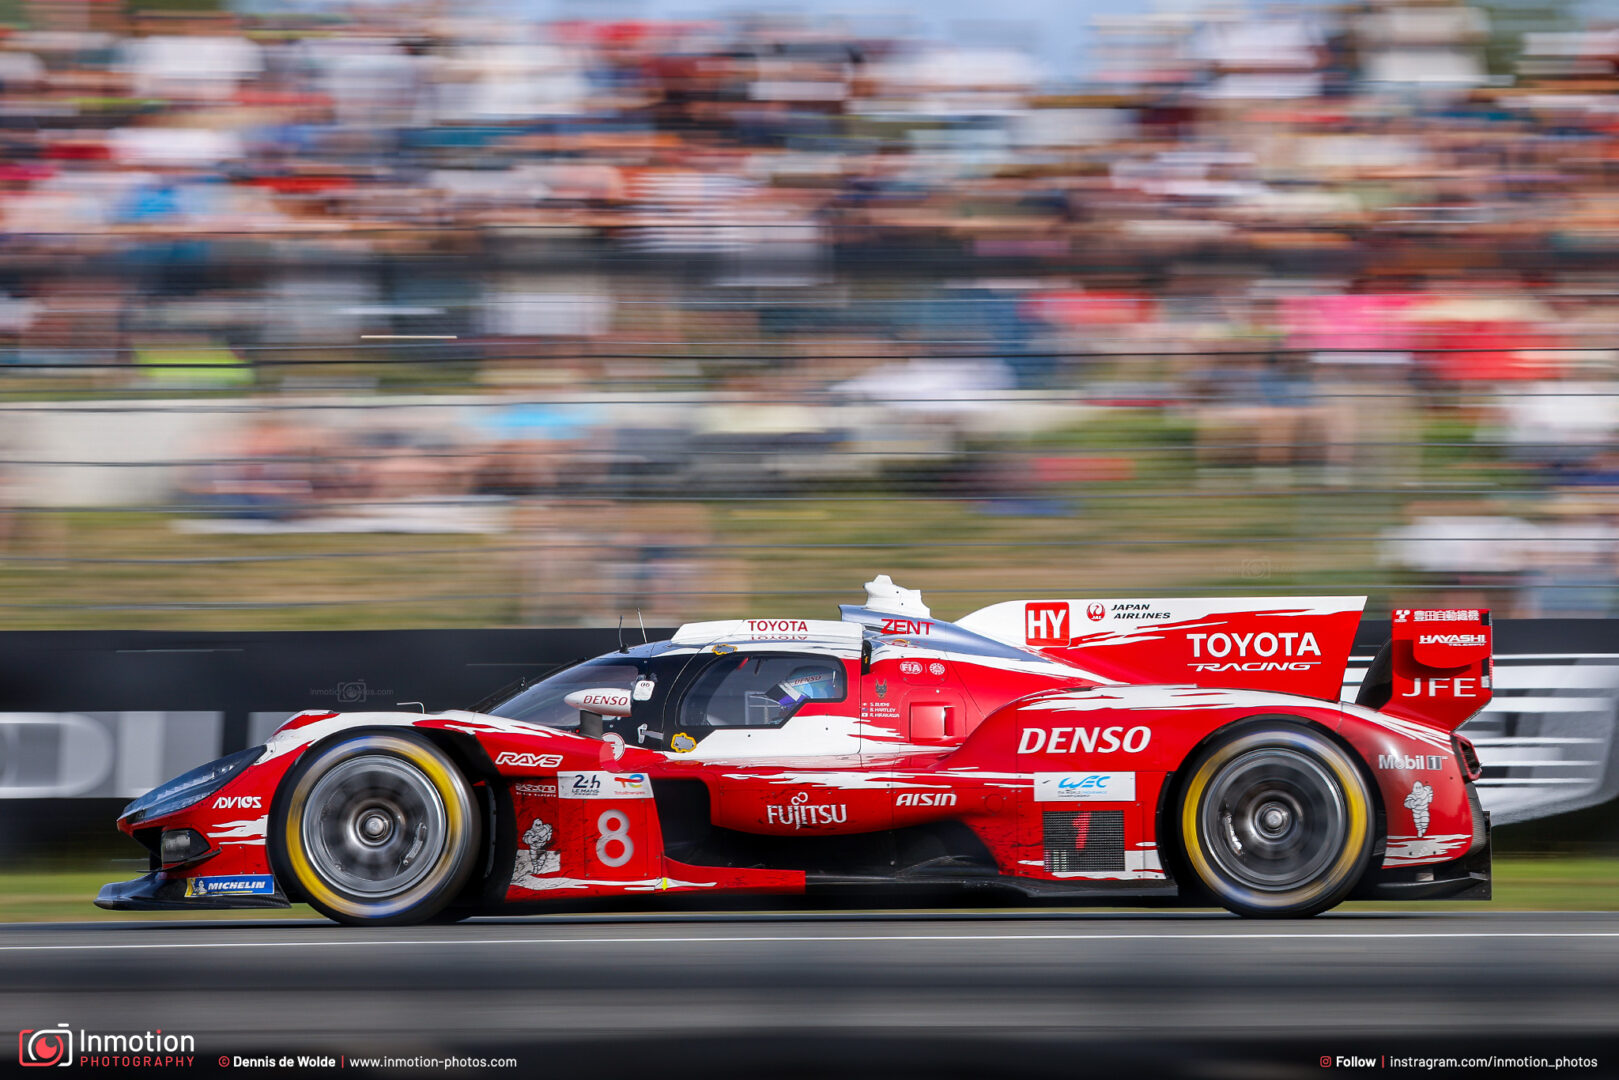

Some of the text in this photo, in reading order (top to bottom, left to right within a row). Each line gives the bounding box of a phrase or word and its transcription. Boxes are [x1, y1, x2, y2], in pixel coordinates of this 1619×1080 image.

[748, 620, 808, 632] TOYOTA
[880, 618, 935, 635] ZENT
[1027, 610, 1067, 639] HY
[1186, 632, 1322, 657] TOYOTA
[1419, 634, 1487, 644] HAYASHI
[1187, 661, 1322, 672] RACING
[1401, 678, 1477, 697] JFE
[583, 696, 628, 706] DENSO
[1017, 726, 1152, 754] DENSO
[496, 752, 563, 767] RAYS
[1378, 754, 1425, 770] Mobil
[572, 774, 600, 789] 24h
[1058, 775, 1111, 788] WEC
[896, 793, 957, 806] AISIN
[767, 792, 847, 830] FUJITSU
[595, 809, 634, 867] 8
[1072, 812, 1092, 849] 1
[208, 881, 265, 890] MICHELIN
